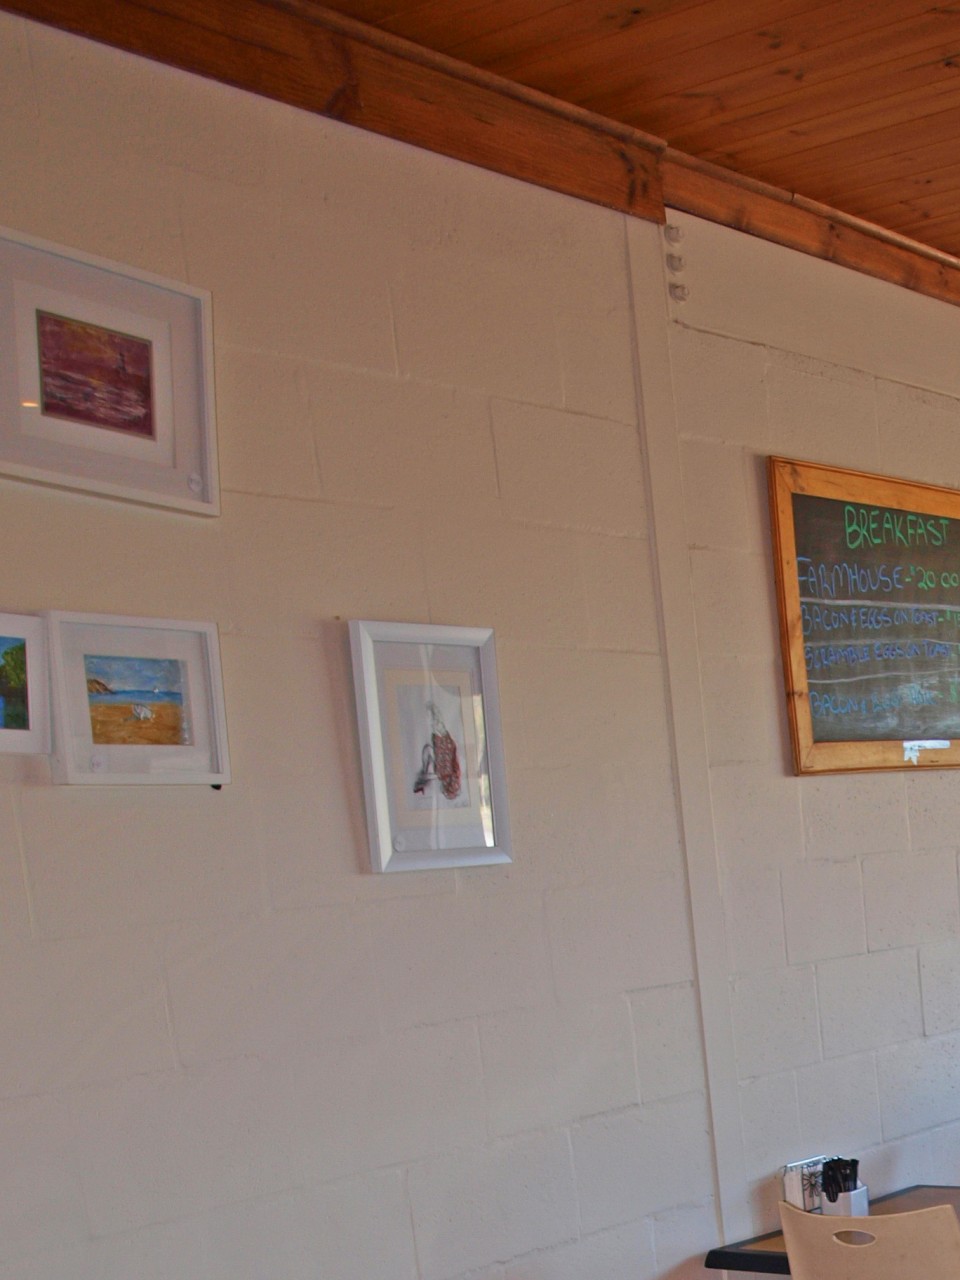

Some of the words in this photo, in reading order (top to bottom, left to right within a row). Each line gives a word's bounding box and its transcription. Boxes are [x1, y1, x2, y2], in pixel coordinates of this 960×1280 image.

[844, 505, 950, 549] BREAKFAST
[797, 556, 904, 599] FARMHOUSE
[801, 604, 849, 635] BACON
[860, 607, 892, 629] EGGS
[894, 609, 909, 625] ON
[911, 606, 938, 628] TOAST
[809, 691, 858, 718] BACON
